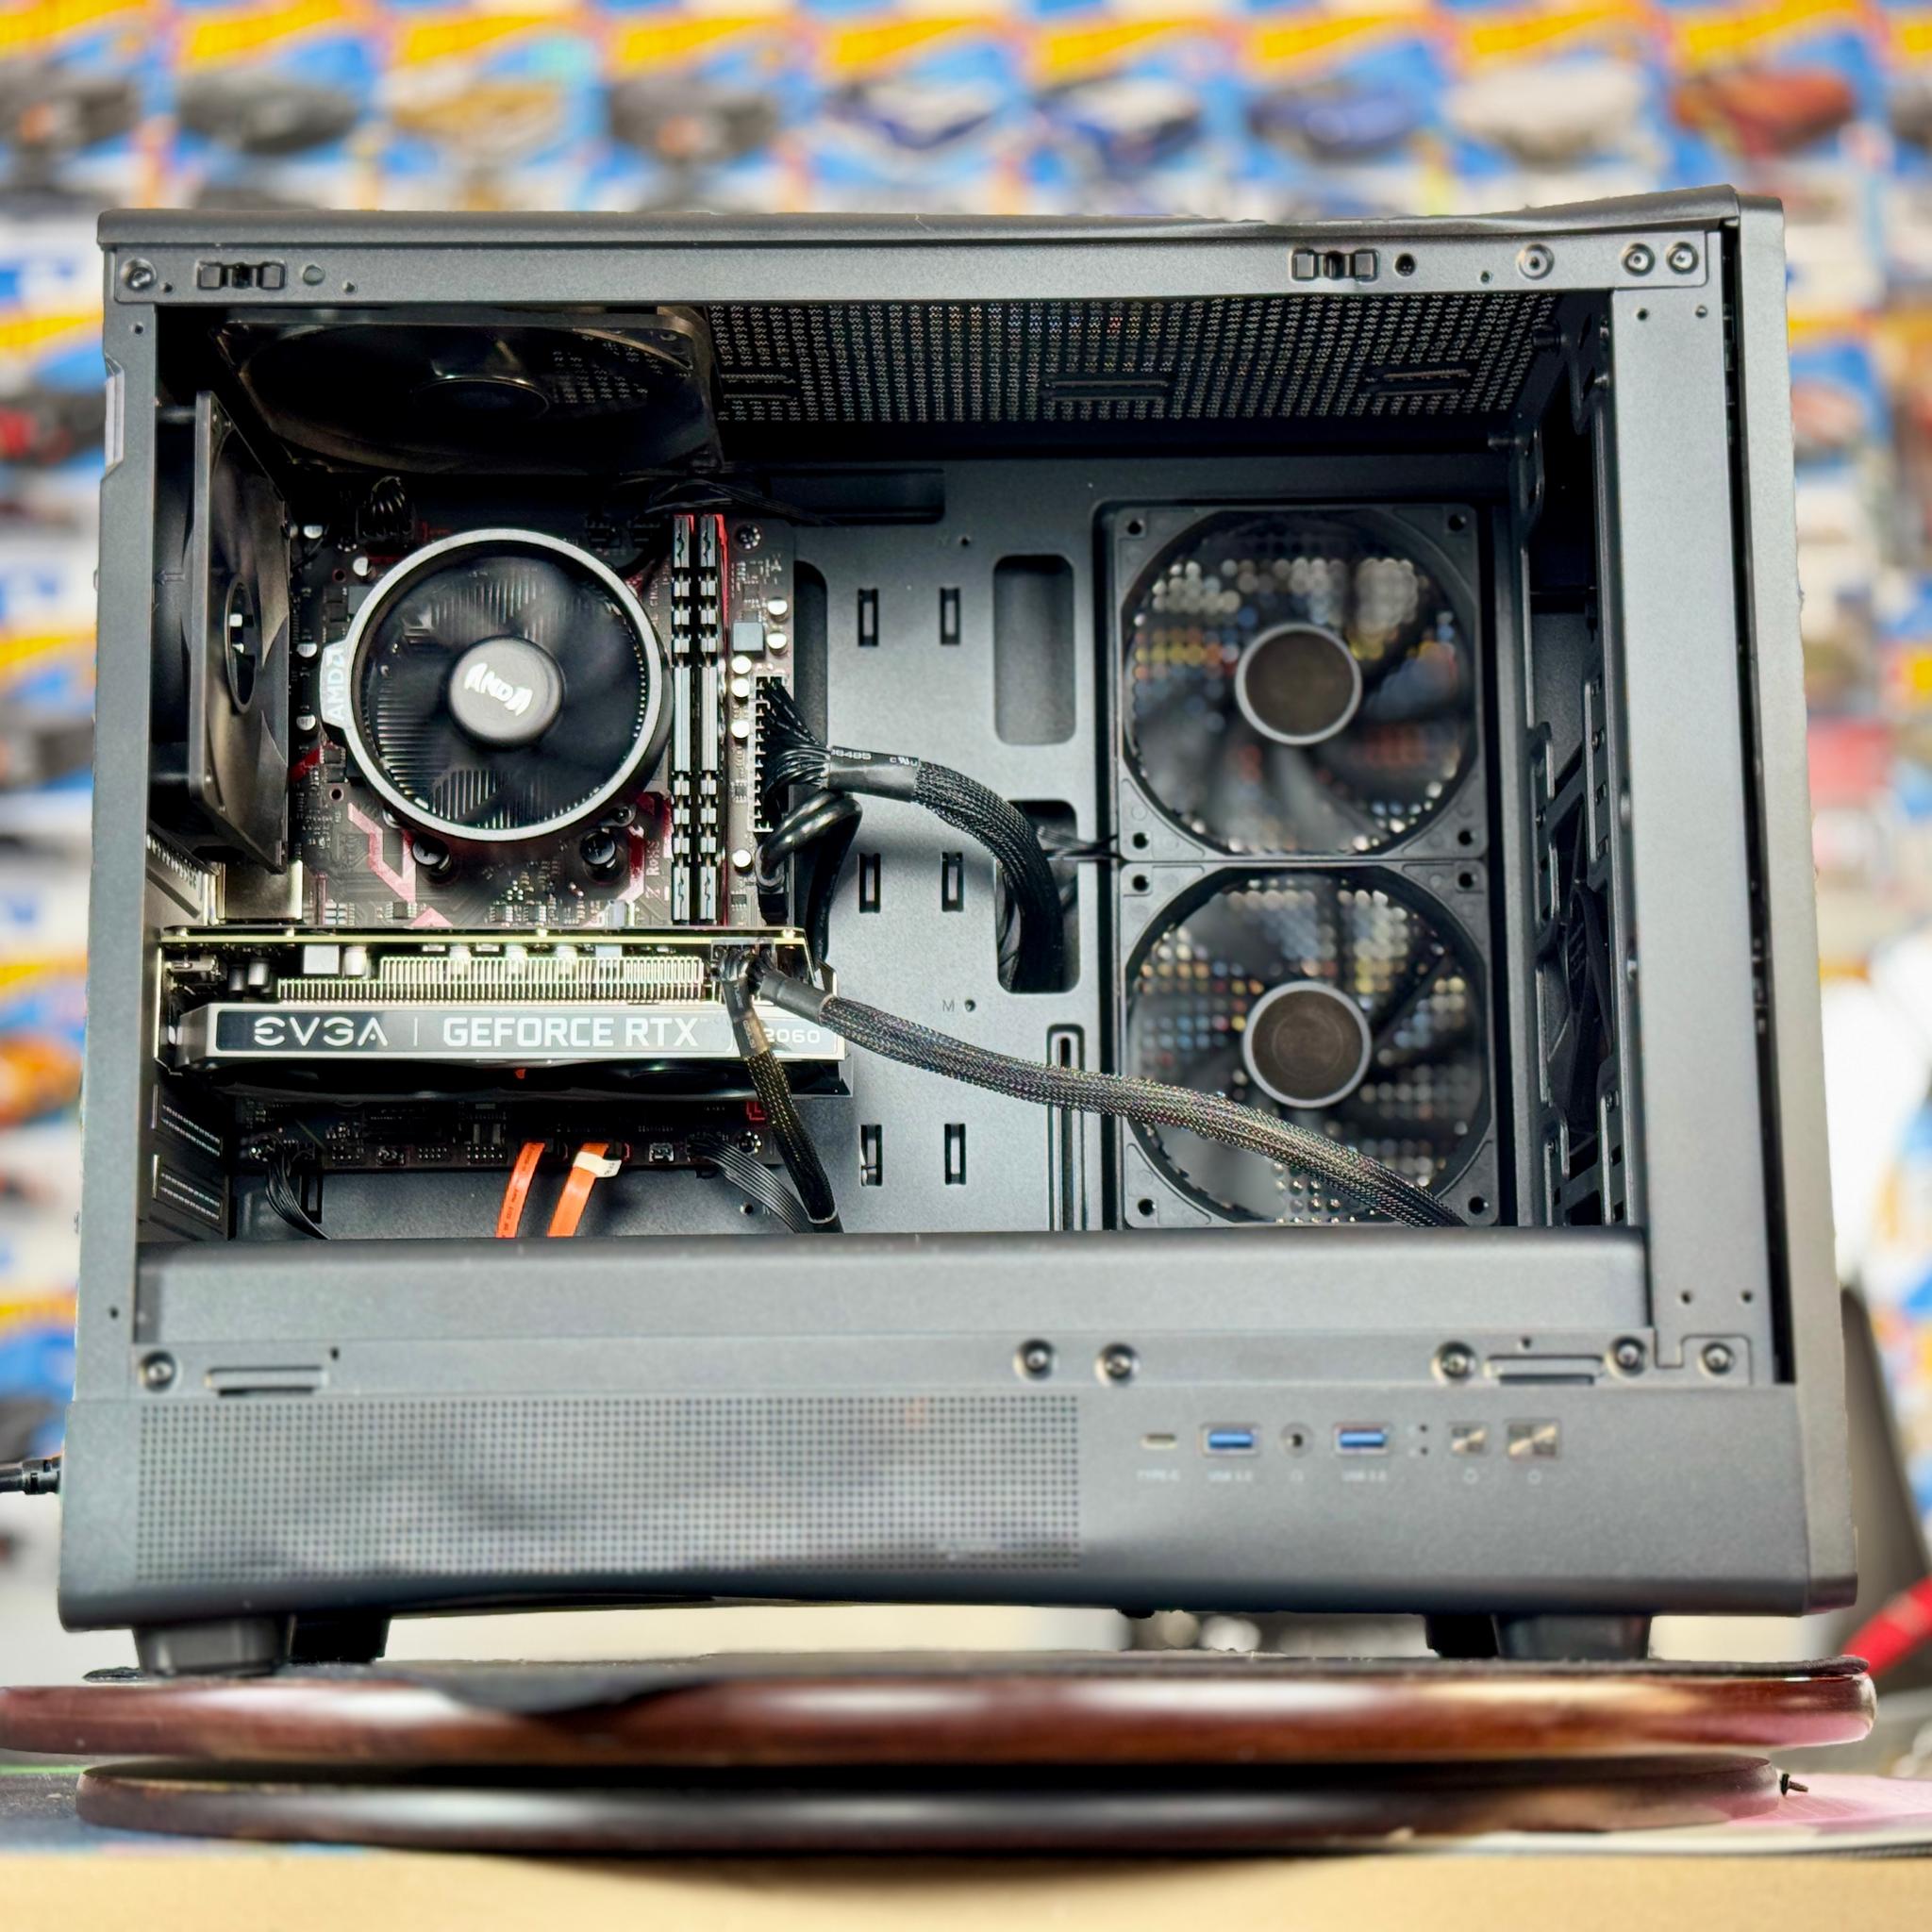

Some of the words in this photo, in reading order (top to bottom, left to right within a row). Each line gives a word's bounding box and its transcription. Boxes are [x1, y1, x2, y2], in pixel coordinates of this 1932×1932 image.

[326, 668, 345, 721] AMD
[254, 1016, 389, 1046] EVGA
[443, 1017, 614, 1047] GEFORCE
[625, 1017, 699, 1047] RTX
[763, 1027, 821, 1044] 2060
